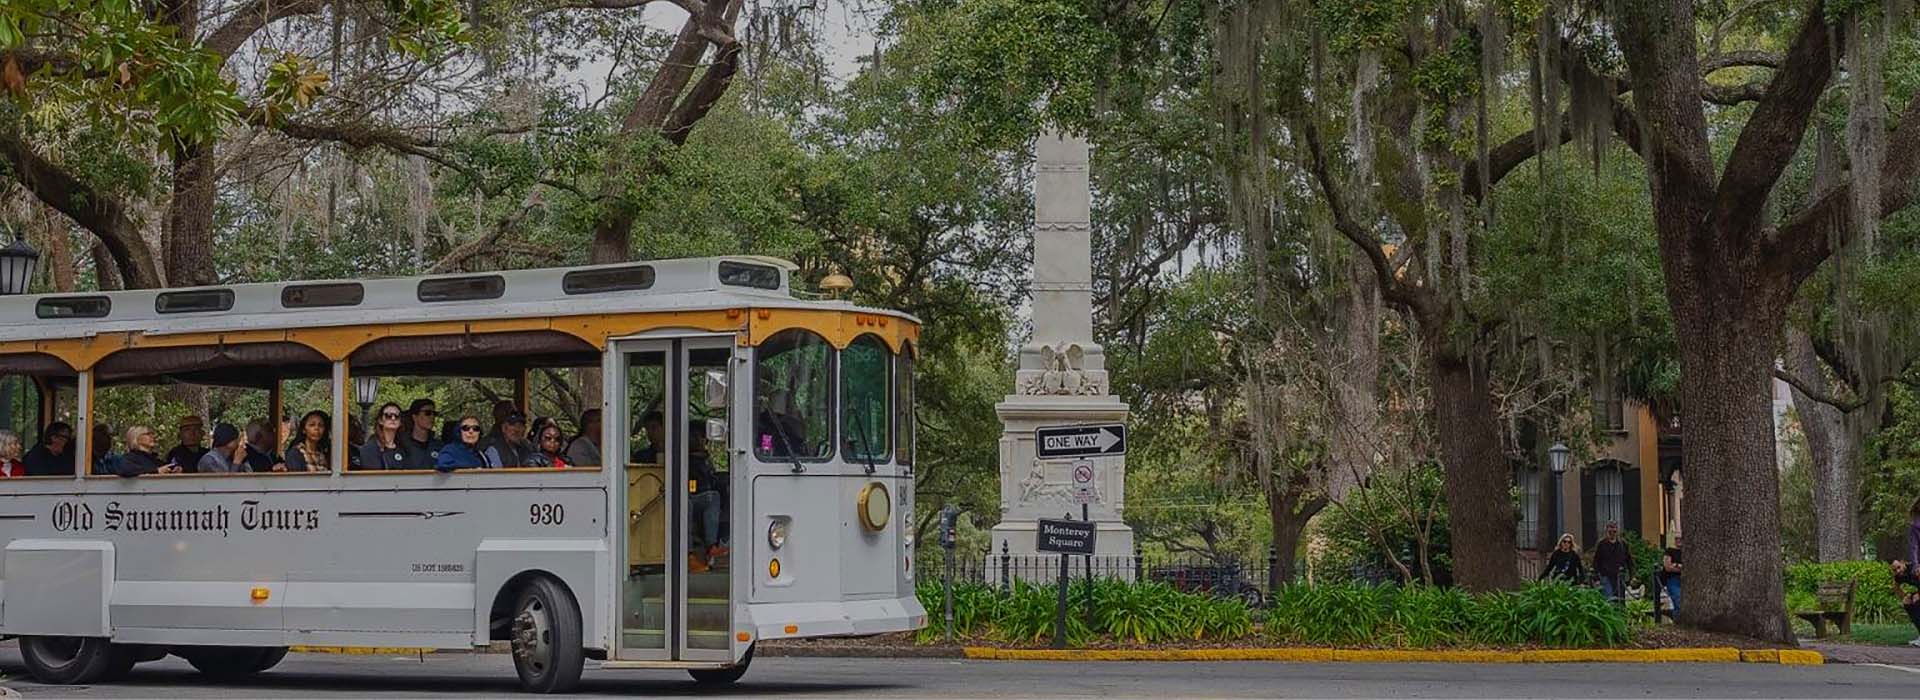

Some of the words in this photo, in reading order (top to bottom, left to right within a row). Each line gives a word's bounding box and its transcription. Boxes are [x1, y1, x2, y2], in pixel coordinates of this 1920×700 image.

[1046, 437, 1071, 449] ONE
[1074, 435, 1099, 447] WAY
[52, 502, 93, 531] Old
[104, 501, 229, 537] Savannah
[240, 500, 319, 531] Tours
[529, 503, 564, 525] 930
[1043, 524, 1091, 537] Monterey
[1048, 536, 1084, 547] Square
